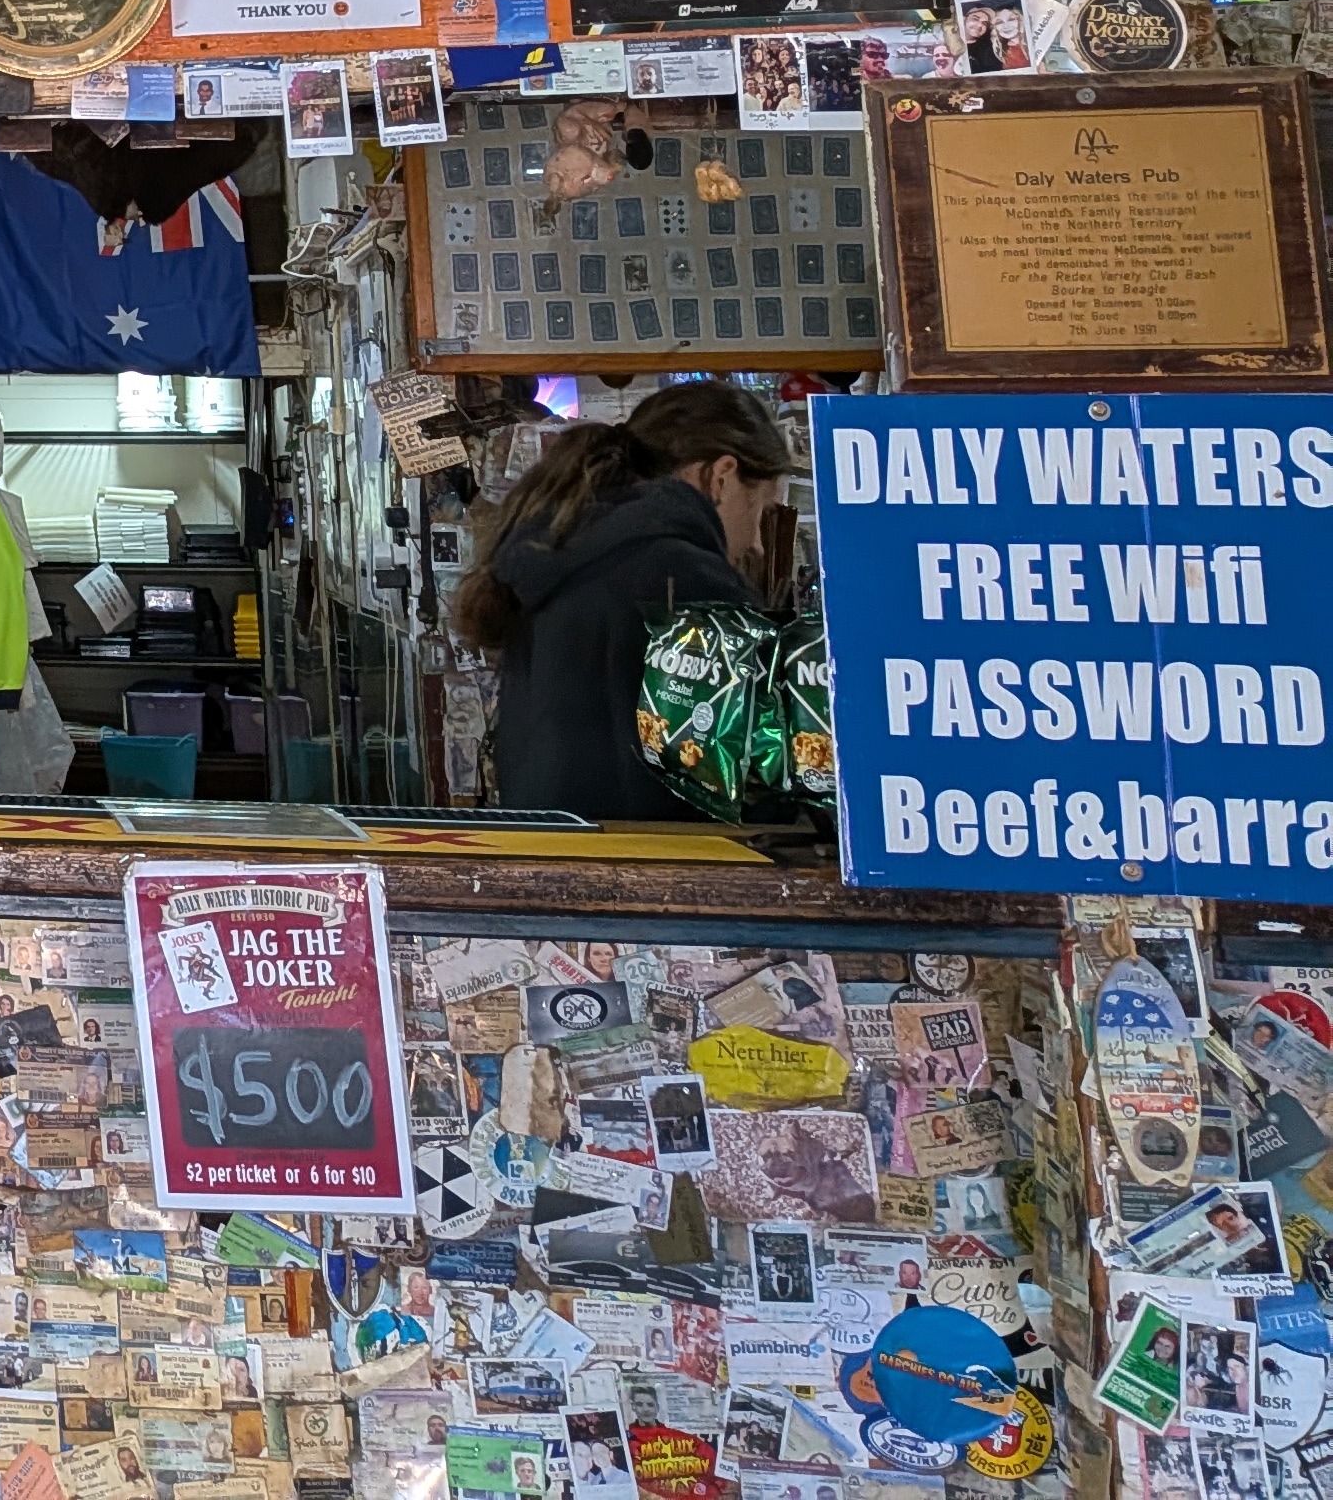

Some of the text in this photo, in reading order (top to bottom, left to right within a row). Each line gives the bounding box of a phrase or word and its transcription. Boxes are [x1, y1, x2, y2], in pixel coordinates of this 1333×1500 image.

[237, 4, 327, 18] THANK YOU
[1015, 168, 1180, 188] Daly Waters Pub
[1040, 218, 1183, 231] the Northern Territory
[1081, 205, 1122, 218] Family
[1128, 205, 1197, 217] Restaurant
[832, 427, 1333, 508] DALY WATERS
[917, 543, 1268, 625] FREE Wifi
[884, 658, 1326, 746] PASSWORD
[880, 774, 1333, 870] Beef&barra
[174, 889, 330, 915] DALY WATERS HISTORIC PUB
[251, 912, 275, 921] 1930
[171, 931, 206, 948] JOKER
[228, 928, 346, 957] JAG THE
[242, 960, 336, 988] JOKER
[277, 984, 359, 1011] Tonight
[926, 1019, 972, 1042] BAD
[716, 1039, 813, 1065] Nett hier.
[179, 1034, 373, 1145] $500
[186, 1162, 376, 1187] $2 per ticket or 6 for $10
[730, 1342, 812, 1357] plumbing
[1015, 1390, 1048, 1426] CLUB
[1261, 1396, 1292, 1412] BSR
